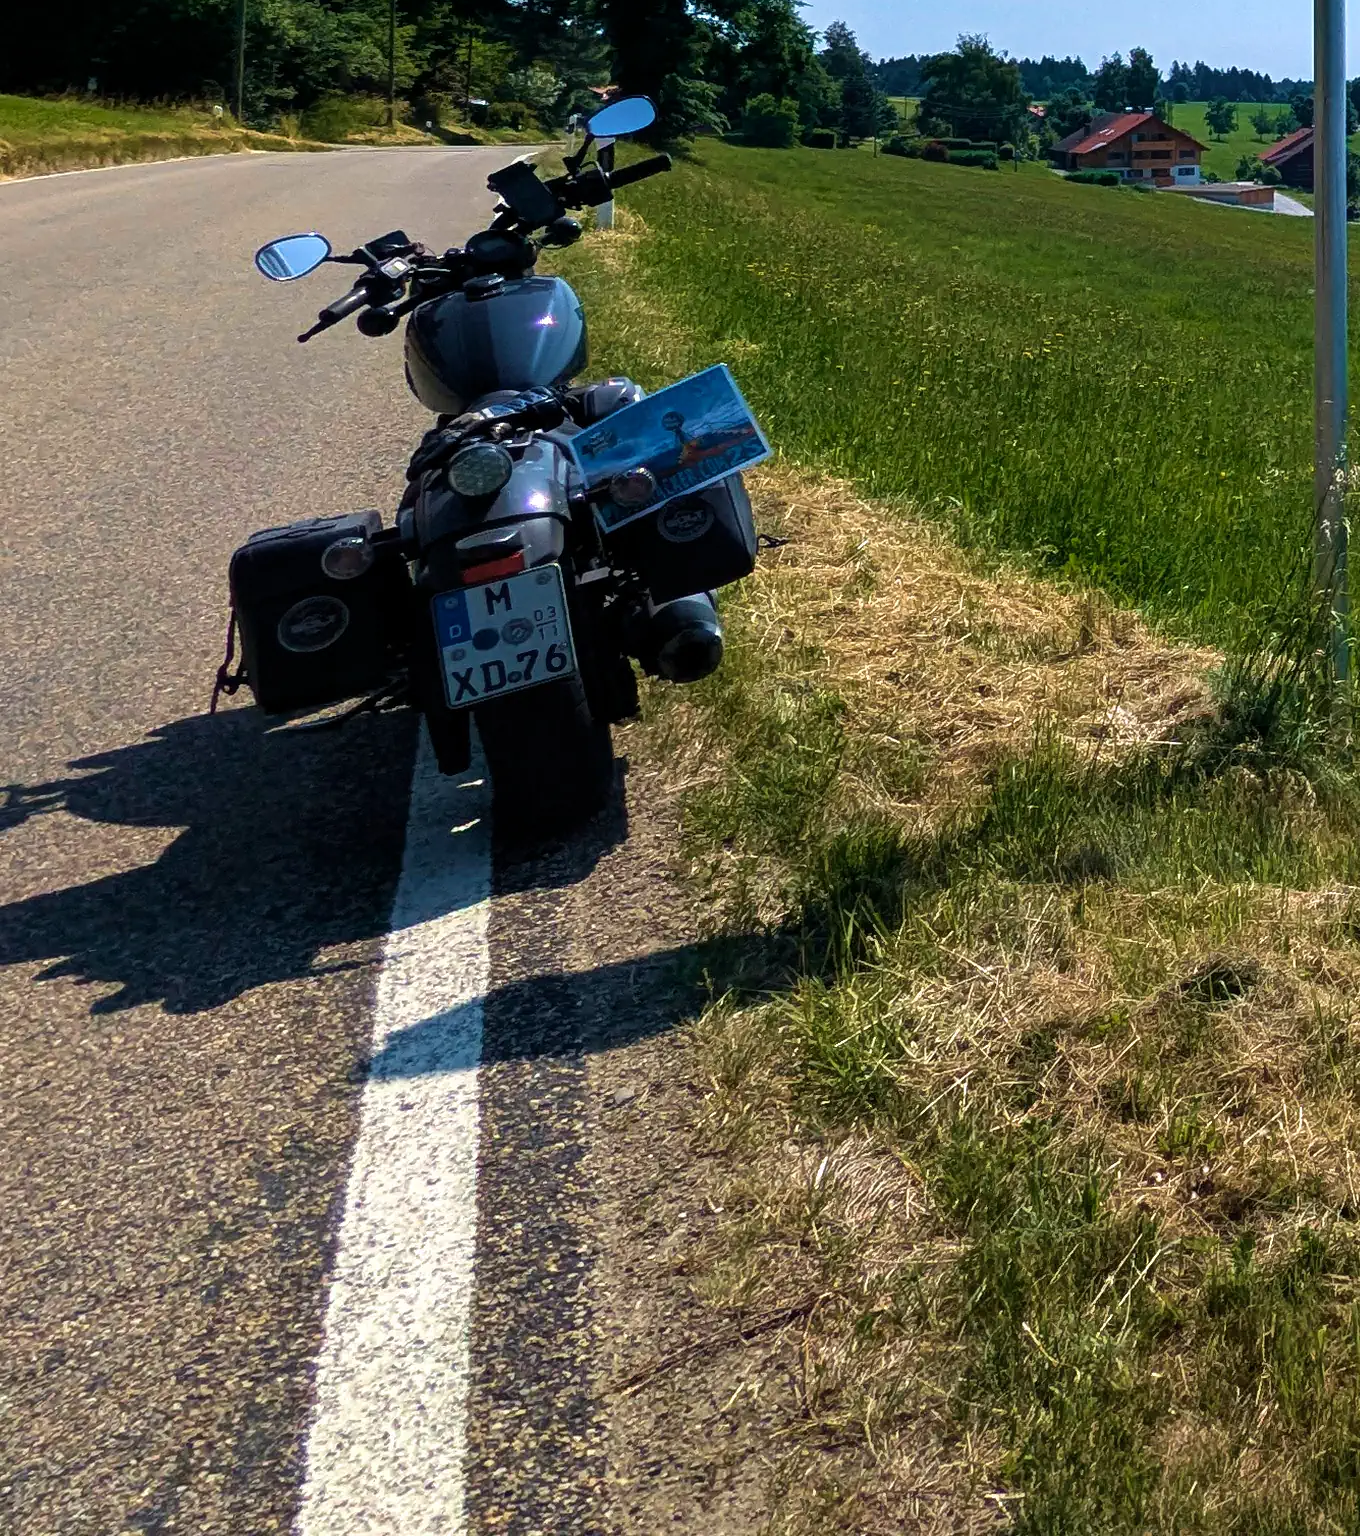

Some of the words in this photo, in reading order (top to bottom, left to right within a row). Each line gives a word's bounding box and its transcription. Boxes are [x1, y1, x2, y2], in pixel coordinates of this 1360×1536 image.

[485, 582, 513, 616] M
[534, 606, 556, 621] 03
[449, 625, 462, 638] D
[538, 624, 559, 640] 11
[516, 644, 567, 680] 76
